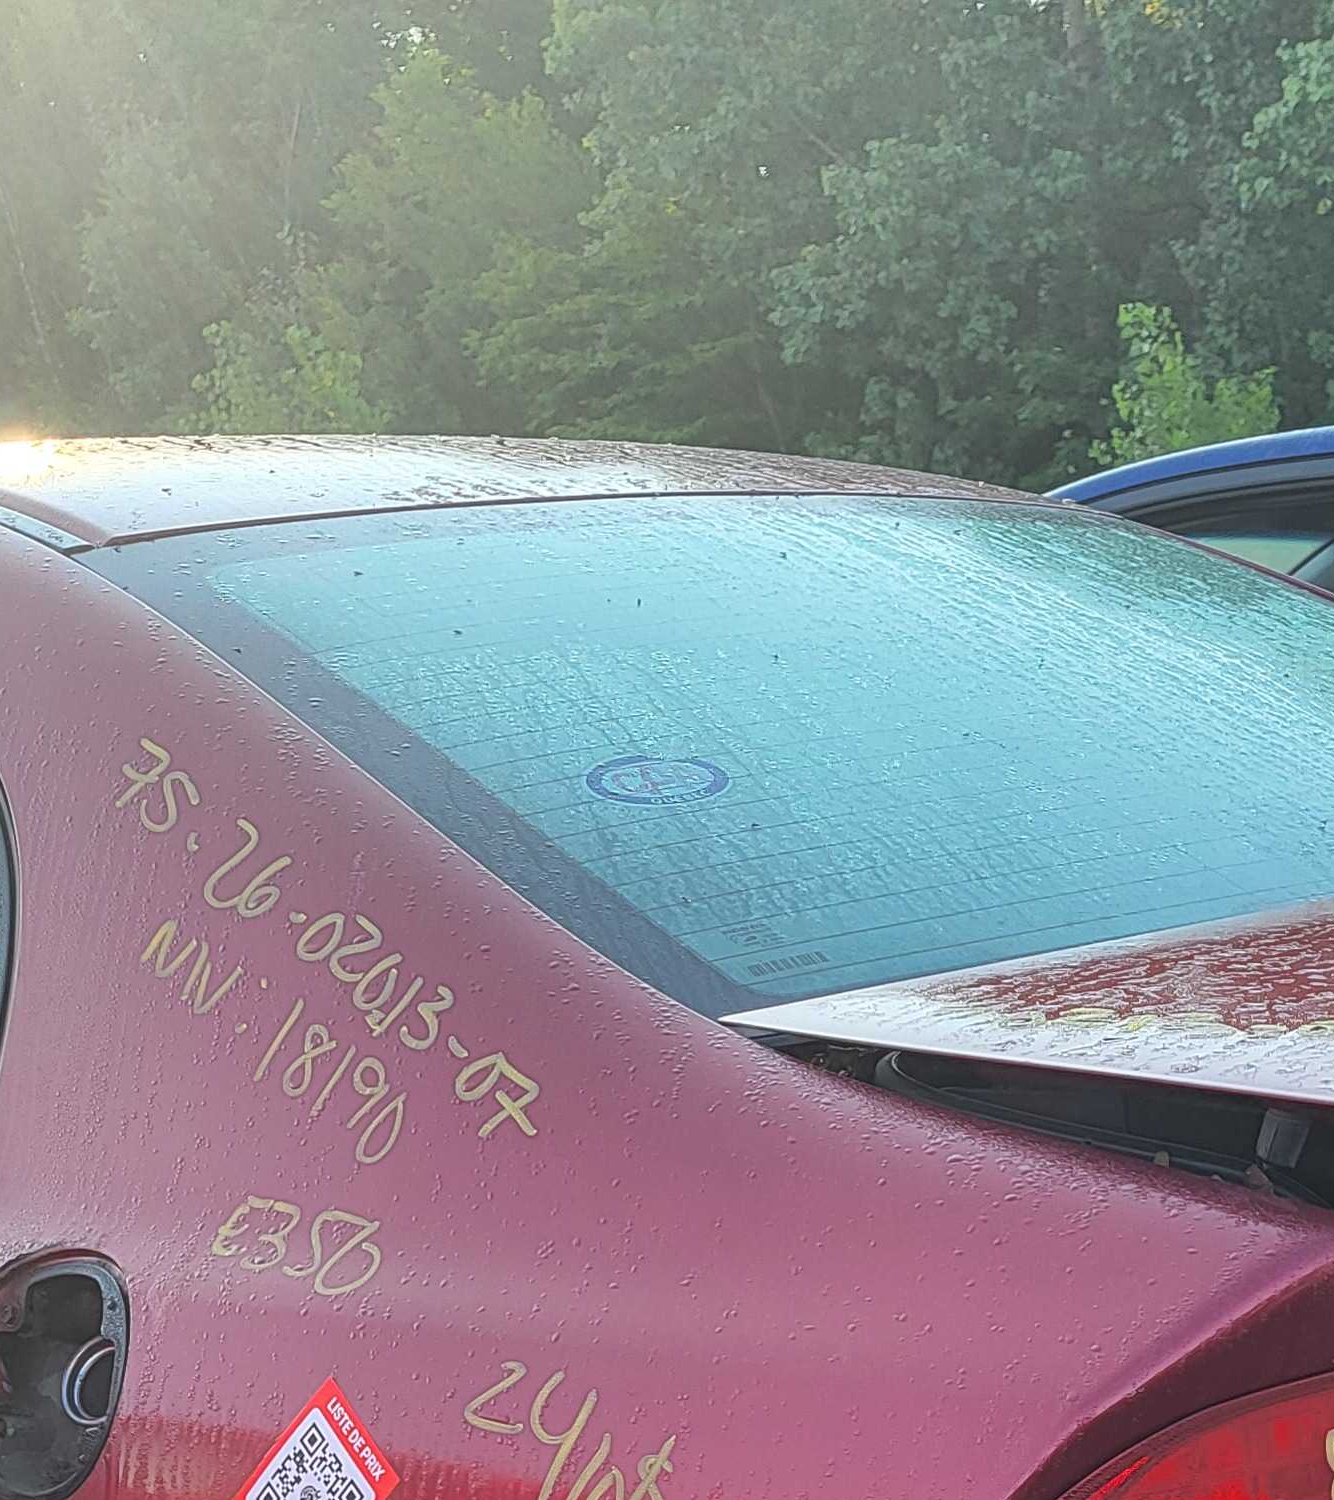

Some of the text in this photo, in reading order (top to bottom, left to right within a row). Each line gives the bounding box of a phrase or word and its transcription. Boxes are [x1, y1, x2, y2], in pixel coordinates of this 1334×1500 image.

[326, 1397, 385, 1482] LISTE DE PRIX
